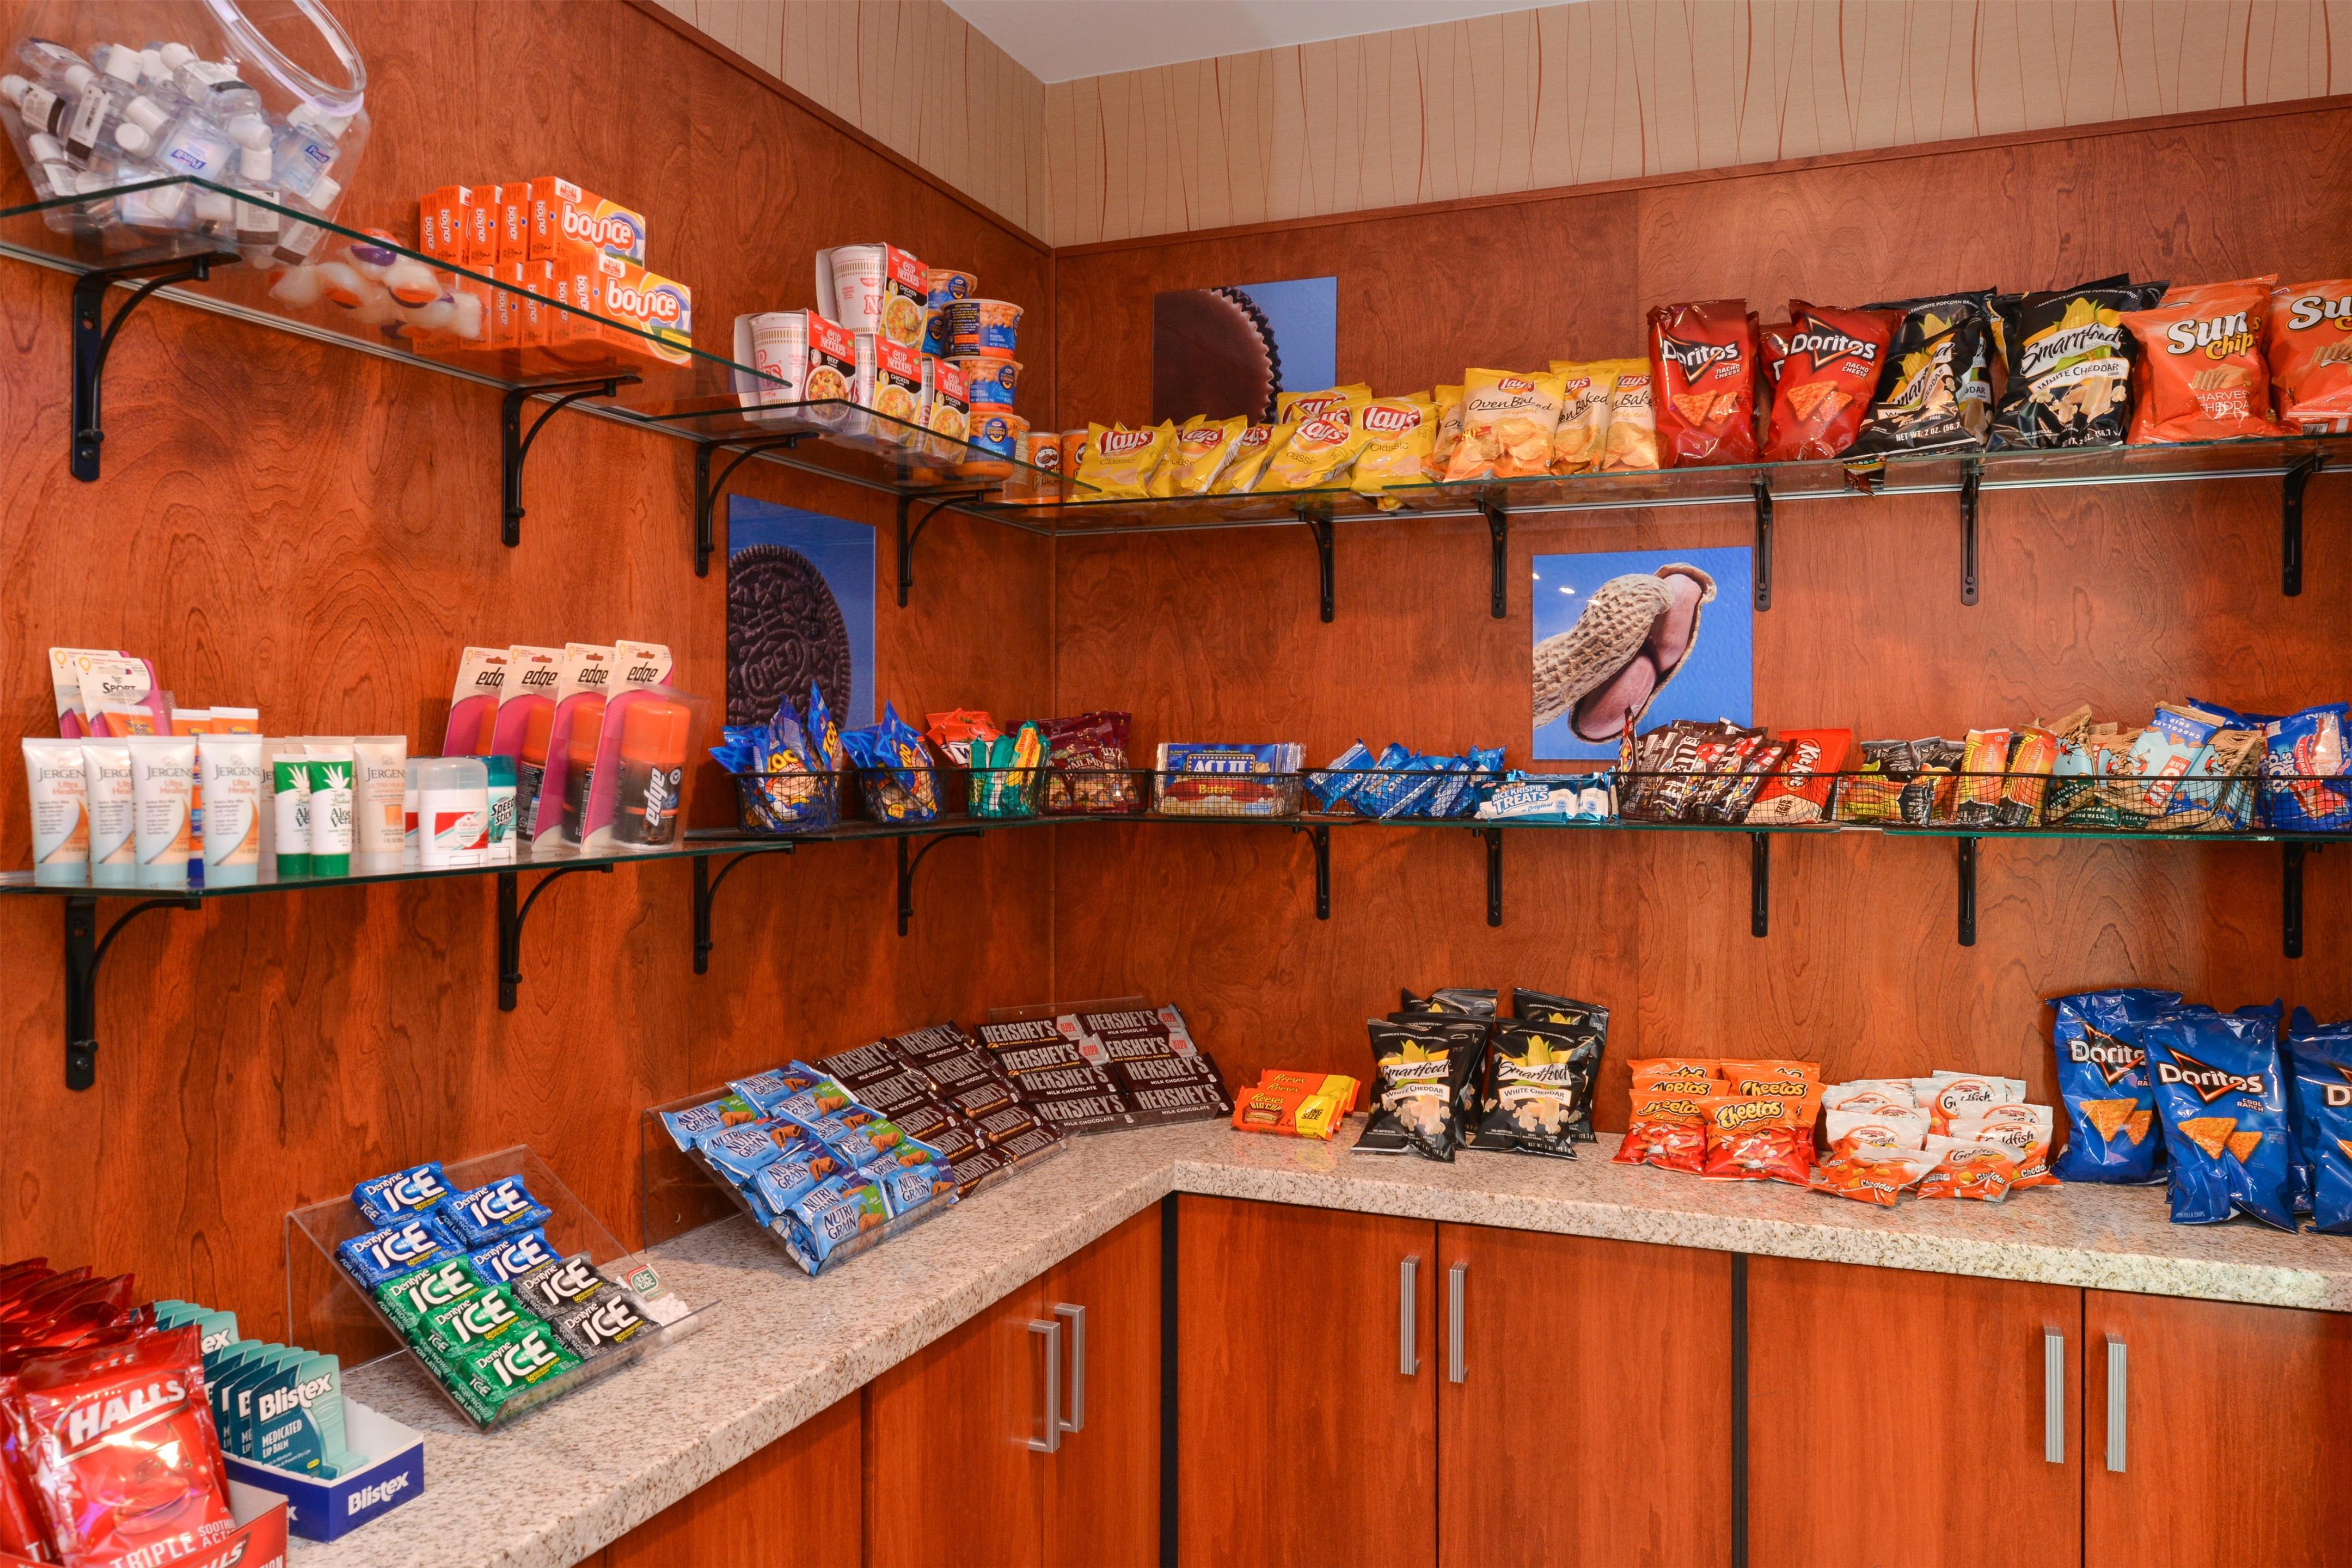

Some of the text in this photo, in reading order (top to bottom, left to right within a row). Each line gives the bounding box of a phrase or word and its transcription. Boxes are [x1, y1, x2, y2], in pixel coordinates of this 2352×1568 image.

[441, 209, 450, 243] bounce
[476, 209, 485, 242] bounce
[507, 206, 517, 240] bounce
[537, 201, 546, 236] bounce
[564, 203, 632, 244] bounce
[425, 217, 434, 250] bounce
[903, 261, 916, 274] CUP
[608, 279, 678, 317] bounce
[900, 284, 917, 297] CHICKEN
[1911, 303, 1935, 314] FAVORITE
[827, 330, 841, 342] CUP
[2166, 311, 2249, 354] Sun
[893, 351, 907, 362] CUP
[1663, 339, 1738, 366] Doritos
[1791, 333, 1877, 360] Doritos
[2020, 322, 2121, 375] Smartfood
[826, 356, 839, 364] BEEF
[1716, 364, 1741, 375] NACHO
[1846, 362, 1870, 373] NACHO
[2073, 363, 2119, 376] CHEDDAR
[891, 374, 909, 384] CHICKEN
[948, 373, 959, 383] CUP
[1715, 368, 1742, 380] CHEESE
[1842, 366, 1868, 379] CHEESE
[945, 396, 961, 406] CHICKEN
[1468, 397, 1509, 411] Oven
[1576, 393, 1610, 414] Baked
[1366, 407, 1419, 431] Lay's
[1104, 431, 1151, 454] Lay's
[1370, 440, 1409, 452] Classic
[1896, 433, 1908, 442] NET
[521, 665, 558, 687] edge
[578, 664, 609, 685] edge
[627, 662, 659, 683] edge
[2152, 719, 2201, 739] CHOCOLATE
[2169, 718, 2191, 728] CHIP
[38, 767, 86, 782] JERGEN
[145, 765, 193, 781] JERGENS
[214, 764, 261, 780] JERGENS
[1193, 760, 1247, 773] ACT II
[2169, 758, 2186, 771] BAR
[160, 787, 189, 795] Healing
[228, 786, 256, 795] Healing
[644, 767, 666, 826] edge
[1199, 784, 1236, 795] Butter
[1492, 785, 1548, 801] RICE KRISPIES
[330, 808, 351, 818] Aloe
[1493, 791, 1549, 814] TREATS
[1528, 801, 1553, 811] Original
[1086, 1010, 1159, 1031] HERSHEY'S
[896, 1024, 963, 1055] HERSHEY'S
[981, 1020, 1058, 1043] HERSHEY'S
[927, 1045, 960, 1059] MILK CHOCOLATE
[1001, 1044, 1080, 1070] HERSHEY'S
[1105, 1036, 1170, 1057] ERSHEY'S
[823, 1041, 897, 1079] HERSHEY'S
[924, 1051, 990, 1085] HERSHEY'S
[1124, 1055, 1210, 1081] HERSHEY'S
[1382, 1059, 1450, 1081] Smartfood
[743, 1074, 773, 1089] NUTRI
[857, 1064, 895, 1081] MILK CHOCOLATE
[965, 1072, 989, 1083] CHOCOLATE
[1019, 1065, 1110, 1091] HERSHEY'S
[1497, 1061, 1568, 1082] Smartfood
[2158, 1062, 2264, 1094] Doritos
[754, 1079, 782, 1095] GRAIN
[853, 1071, 926, 1109] HERSHEY'S
[956, 1083, 1008, 1110] HERSHEY'S
[1062, 1085, 1097, 1094] CHOCOLATE
[1134, 1083, 1221, 1110] HERSHEY'S
[1385, 1085, 1443, 1098] WHITE CHEDDAR
[1504, 1088, 1565, 1098] WHITE CHEDDAR
[1739, 1080, 1808, 1097] Cheetos
[899, 1095, 924, 1108] CHOCOLATE
[1035, 1094, 1126, 1121] HERSHEY'S
[1176, 1105, 1211, 1113] CHOCOLATE
[1250, 1102, 1282, 1112] BIG CUP
[2237, 1101, 2265, 1113] RANCH
[2242, 1098, 2263, 1108] COOL
[677, 1106, 710, 1125] NUTRI
[685, 1113, 720, 1132] GRAIN
[979, 1106, 1031, 1134] HERSHEY'S
[1079, 1116, 1115, 1125] CHOCOLATE
[1717, 1100, 1784, 1130] Cheetos
[725, 1130, 758, 1154] NUTRI
[738, 1137, 770, 1159] GRAIN
[1002, 1128, 1055, 1156] HERSHEY'S
[767, 1162, 798, 1182] NUTRI
[777, 1168, 809, 1190] GRAIN
[364, 1172, 404, 1196] Dentyne
[383, 1167, 445, 1213] ICE
[897, 1174, 925, 1193] NUTRI
[902, 1184, 929, 1203] GRAIN
[1860, 1179, 1896, 1193] Cheddar
[453, 1187, 489, 1211] Dentyne
[470, 1180, 529, 1228] ICE
[802, 1187, 832, 1212] NUTRI
[360, 1203, 379, 1221] ICE
[823, 1203, 853, 1231] NUTRI
[827, 1216, 857, 1240] GRAIN
[352, 1227, 393, 1253] Dentyne
[371, 1221, 436, 1270] ICE
[473, 1240, 510, 1265] Dentyne
[491, 1233, 550, 1282] ICE
[351, 1269, 368, 1289] LATER
[389, 1269, 431, 1297] Dentyne
[409, 1261, 474, 1314] ICE
[522, 1264, 558, 1290] Dentyne
[541, 1257, 599, 1306] ICE
[635, 1272, 651, 1283] tic
[638, 1280, 657, 1290] tac
[434, 1299, 471, 1325] Dentyne
[452, 1288, 516, 1344] ICE
[564, 1302, 599, 1330] Dentyne
[581, 1295, 639, 1346] ICE
[428, 1334, 449, 1353] ICE
[475, 1341, 513, 1369] Dentyne
[492, 1330, 557, 1387] ICE
[258, 1373, 333, 1423] Blistex
[469, 1377, 491, 1398] ICE
[69, 1379, 187, 1448] HALLS
[262, 1419, 303, 1449] MEDICATED
[262, 1440, 289, 1459] LIP BALM
[347, 1472, 409, 1516] Blistex
